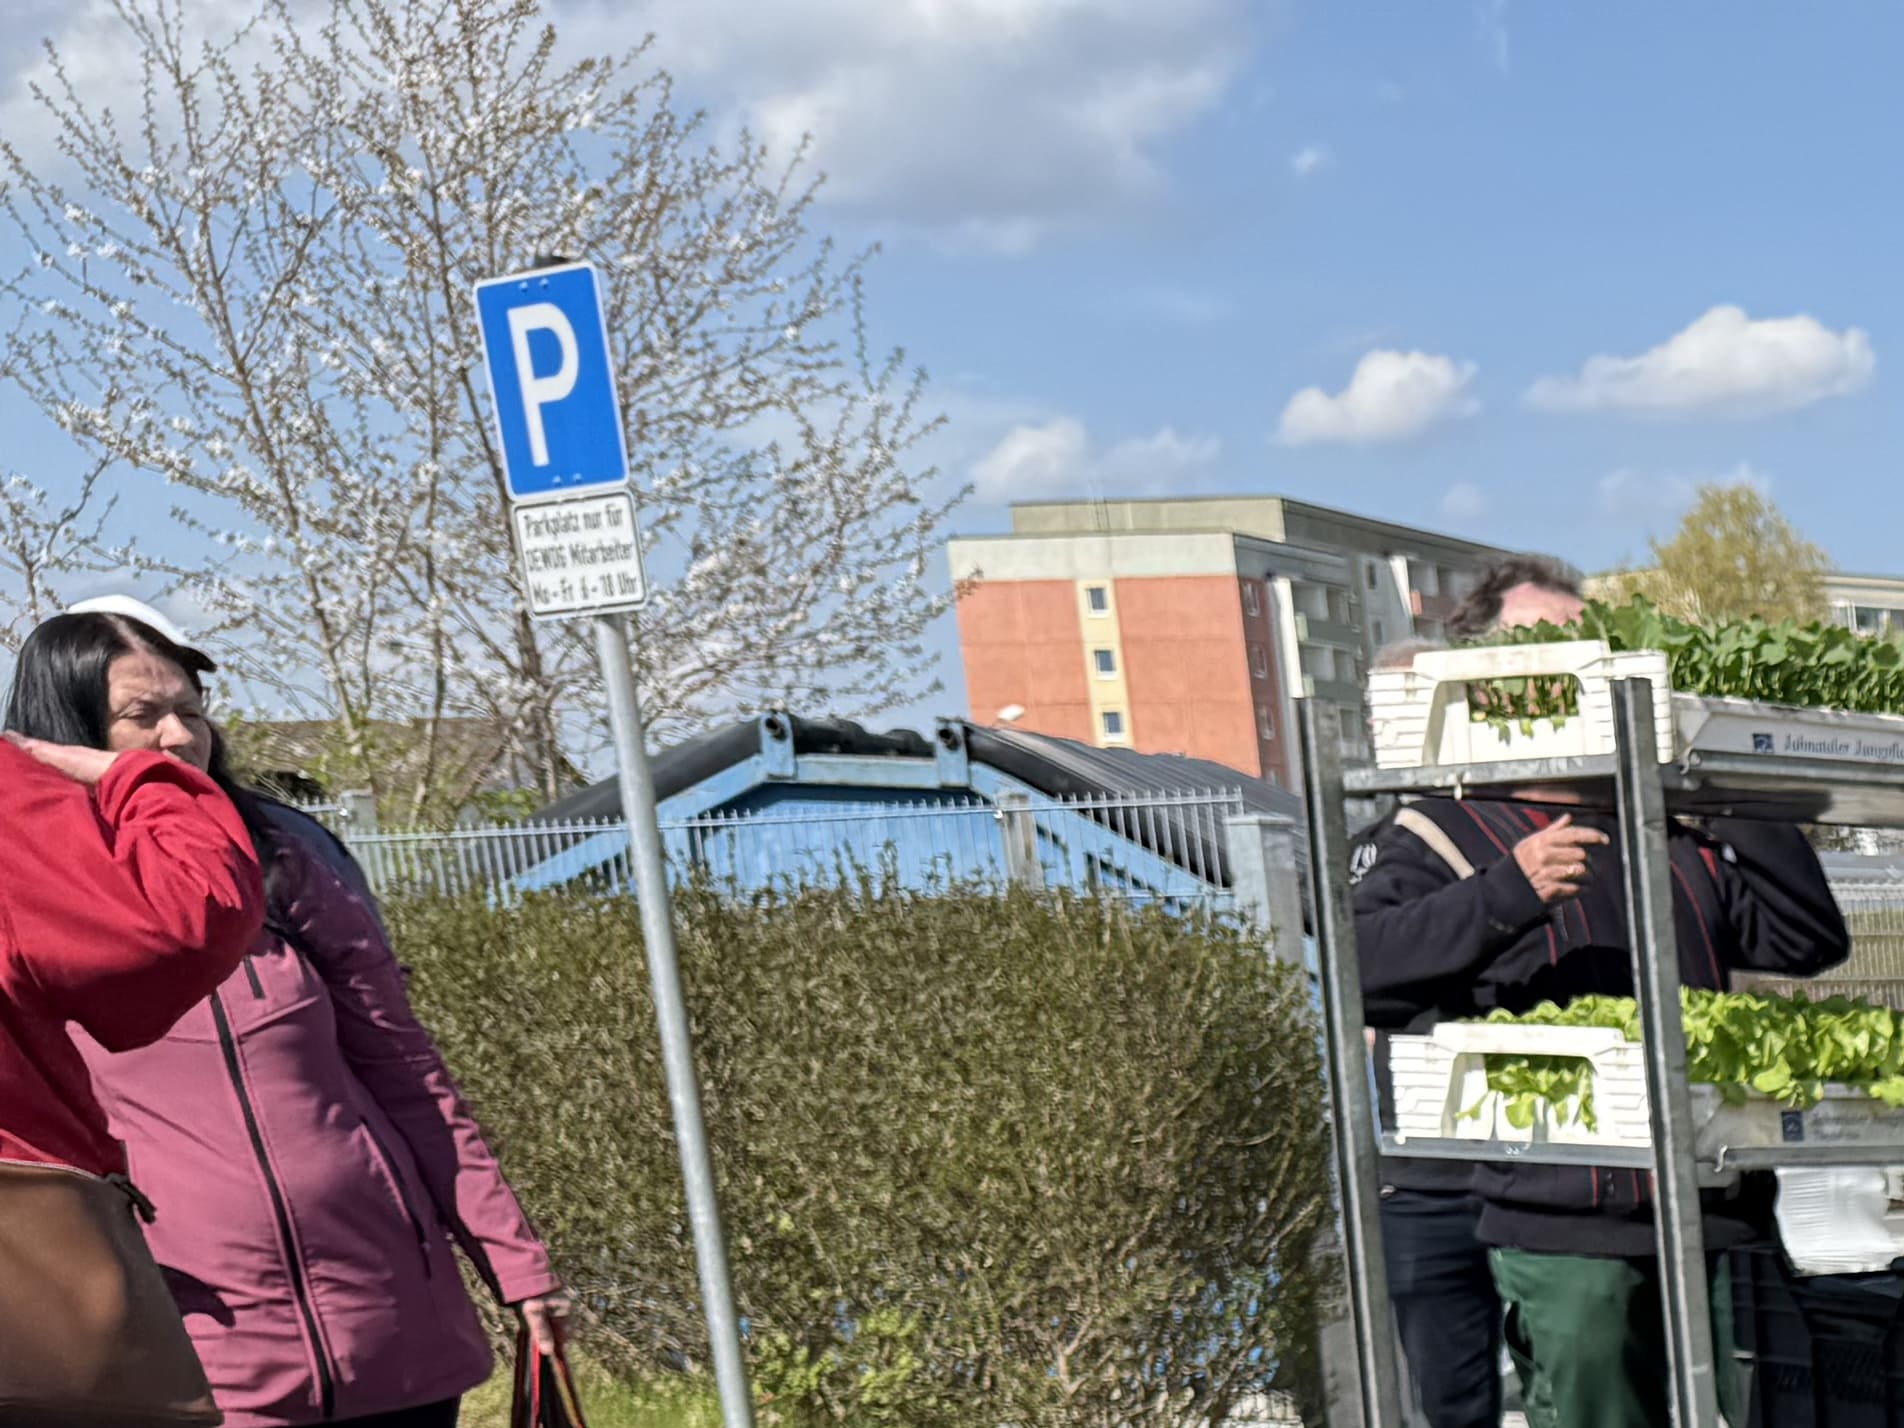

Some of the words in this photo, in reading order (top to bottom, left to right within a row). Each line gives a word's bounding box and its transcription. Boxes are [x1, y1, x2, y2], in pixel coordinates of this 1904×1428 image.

[507, 302, 580, 467] P
[524, 511, 580, 539] Parkplatz
[583, 511, 602, 530] nur
[605, 503, 623, 528] für
[568, 538, 633, 567] Mitarbeiter
